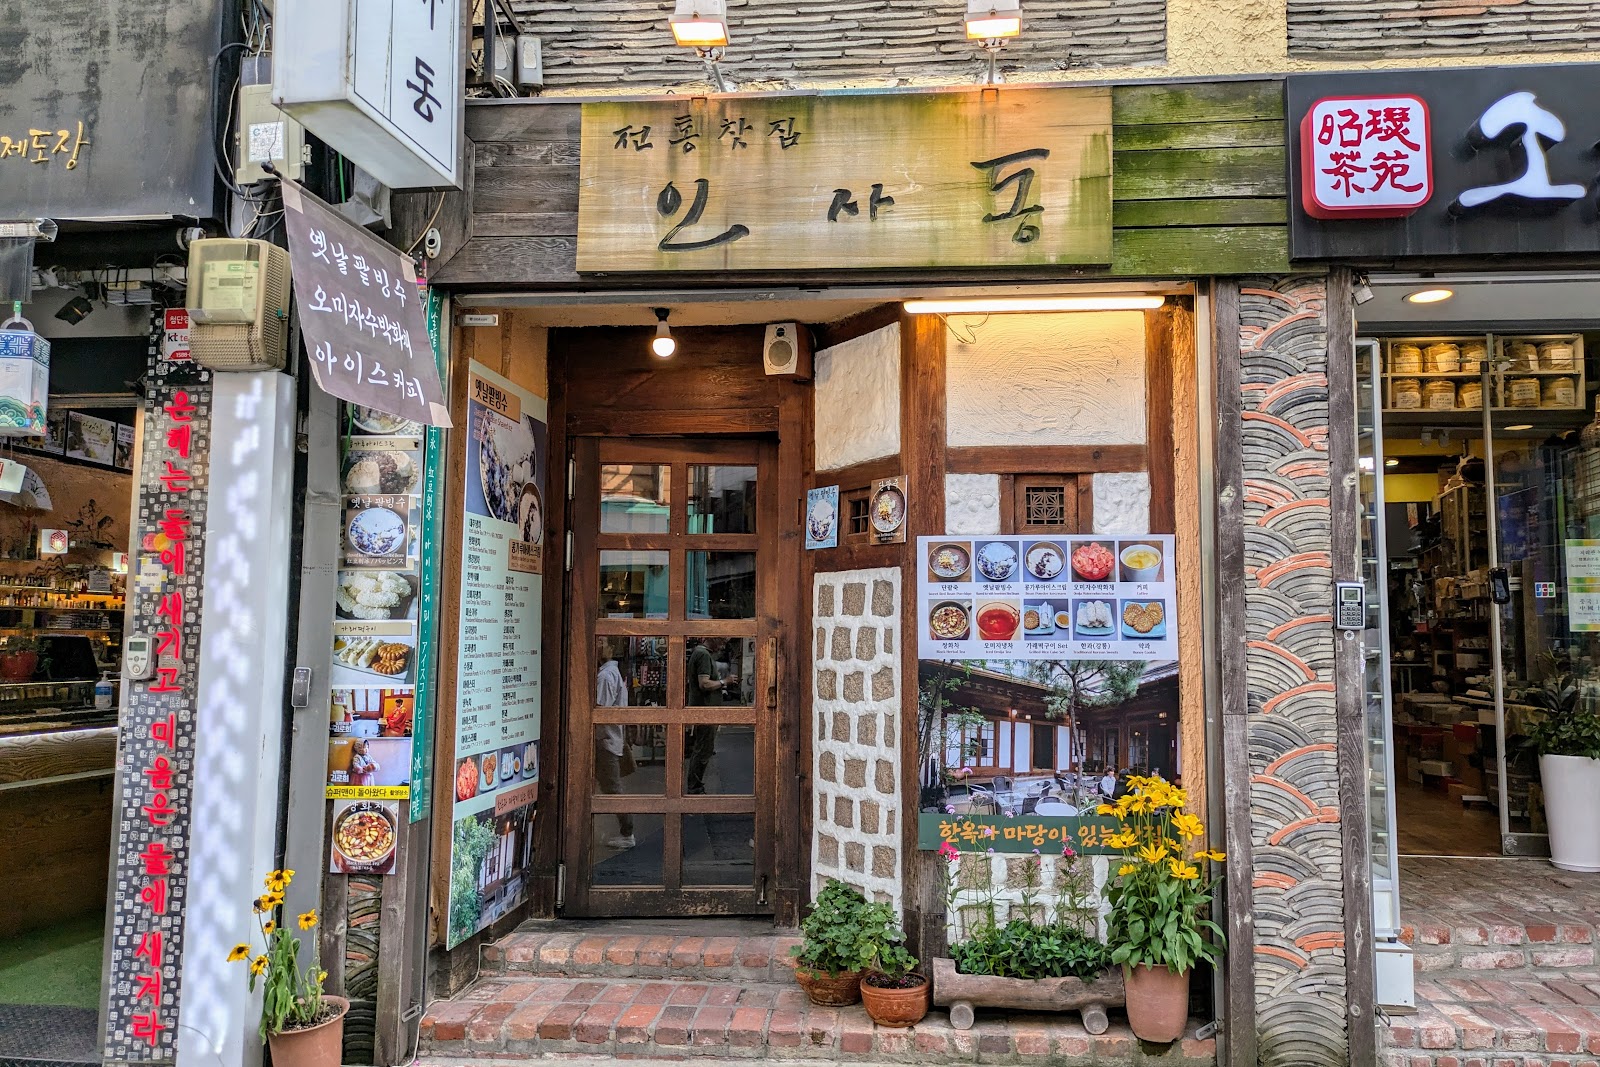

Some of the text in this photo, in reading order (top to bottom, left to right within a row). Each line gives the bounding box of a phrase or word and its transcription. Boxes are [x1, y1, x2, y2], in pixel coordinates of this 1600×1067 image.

[0, 121, 92, 171] 제도장
[656, 147, 1050, 252] 인사동
[167, 332, 178, 342] kt
[315, 341, 426, 407] 아이스커피
[160, 391, 196, 492] 은혜는
[351, 496, 373, 509] 옛날
[158, 508, 191, 576] 돌에
[1024, 584, 1067, 592] 콩가루아이스크림
[148, 592, 183, 693] 새기고
[984, 642, 1013, 650] 오미자냉차
[143, 711, 178, 826] 미움은
[326, 787, 356, 798] 슈퍼맨이
[358, 787, 387, 798] 돌아왔다
[939, 820, 1000, 845] 한옥과
[1003, 823, 1069, 846] 마당이
[138, 842, 174, 915] 물에
